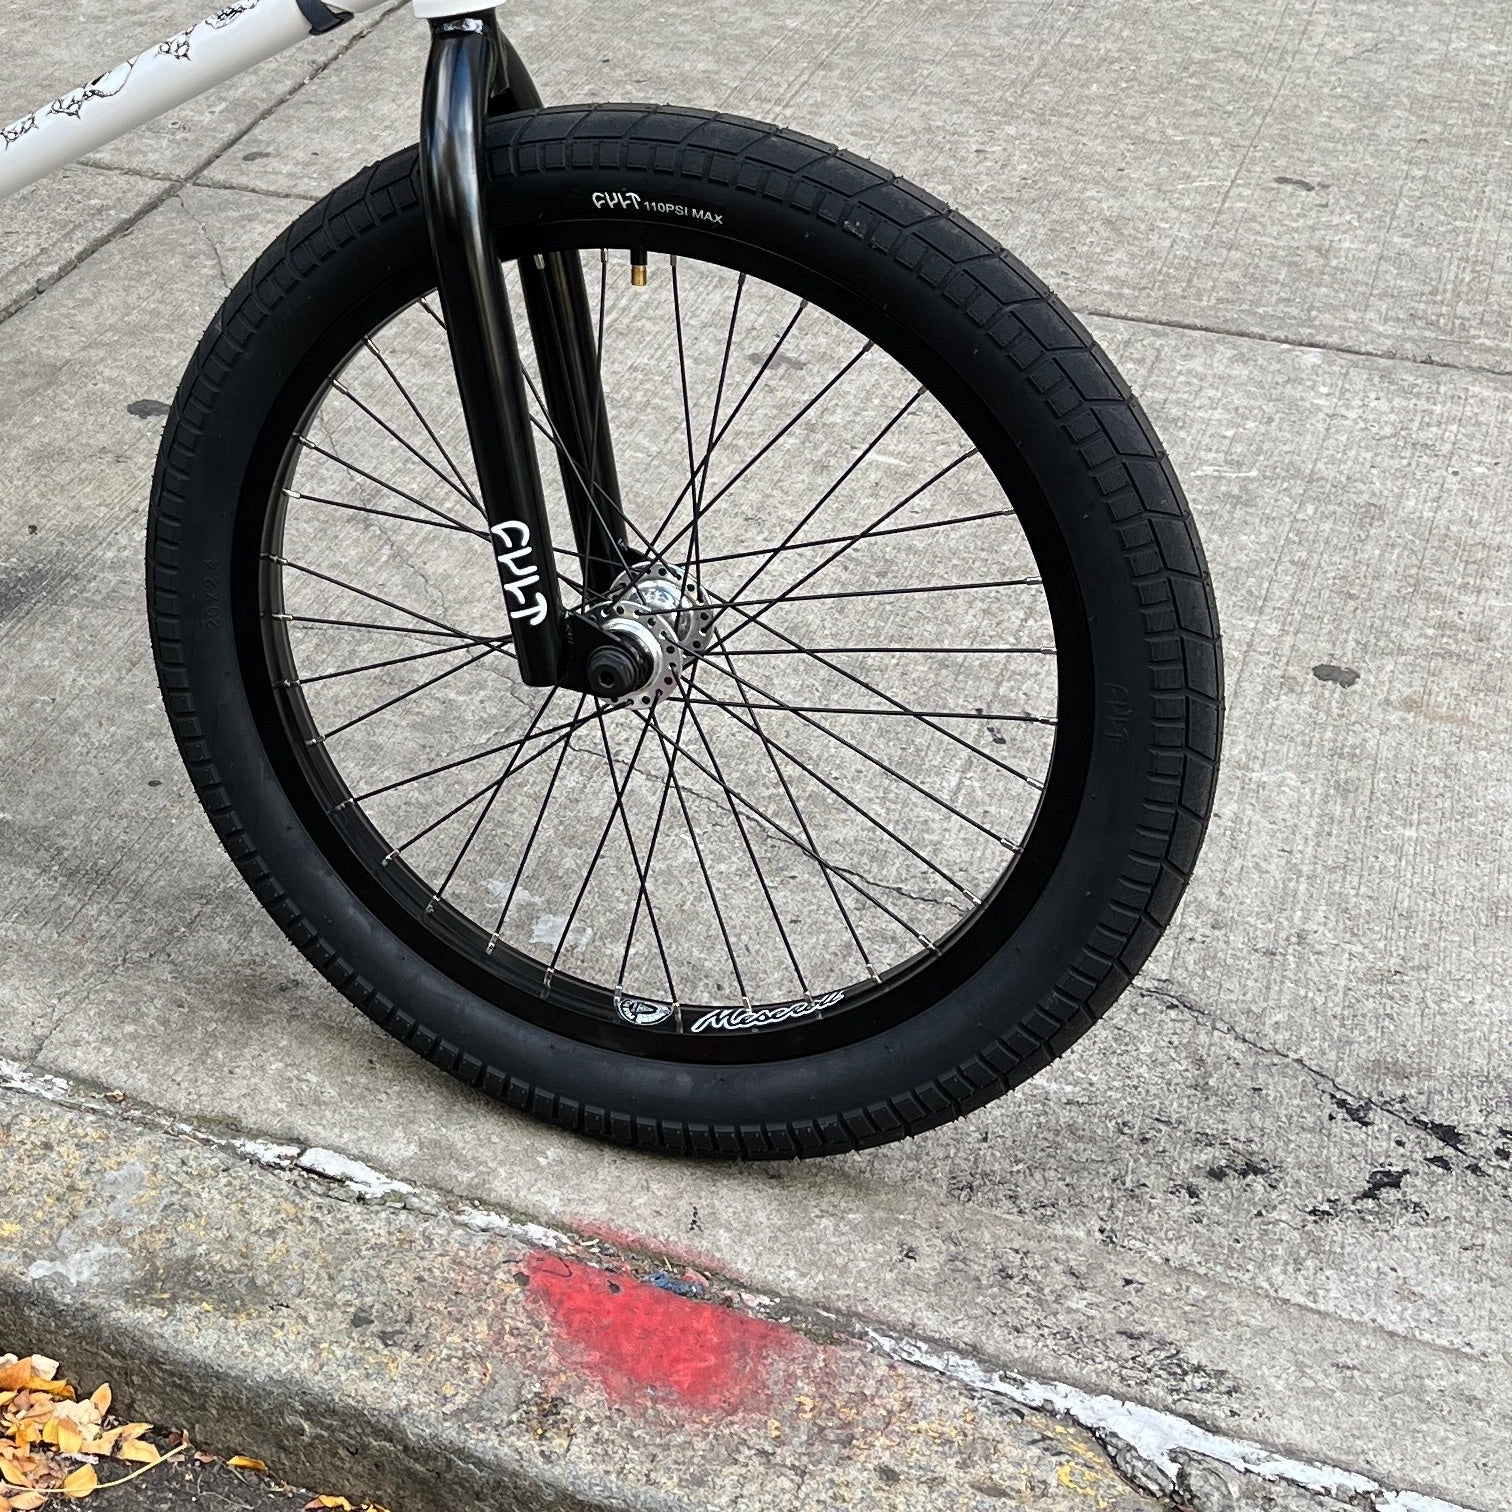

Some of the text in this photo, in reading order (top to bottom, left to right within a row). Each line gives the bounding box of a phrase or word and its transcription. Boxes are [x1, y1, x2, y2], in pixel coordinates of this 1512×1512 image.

[592, 191, 725, 226] CULT 110PSI MAX
[490, 519, 548, 627] CULT
[691, 990, 846, 1034] Meseroll
